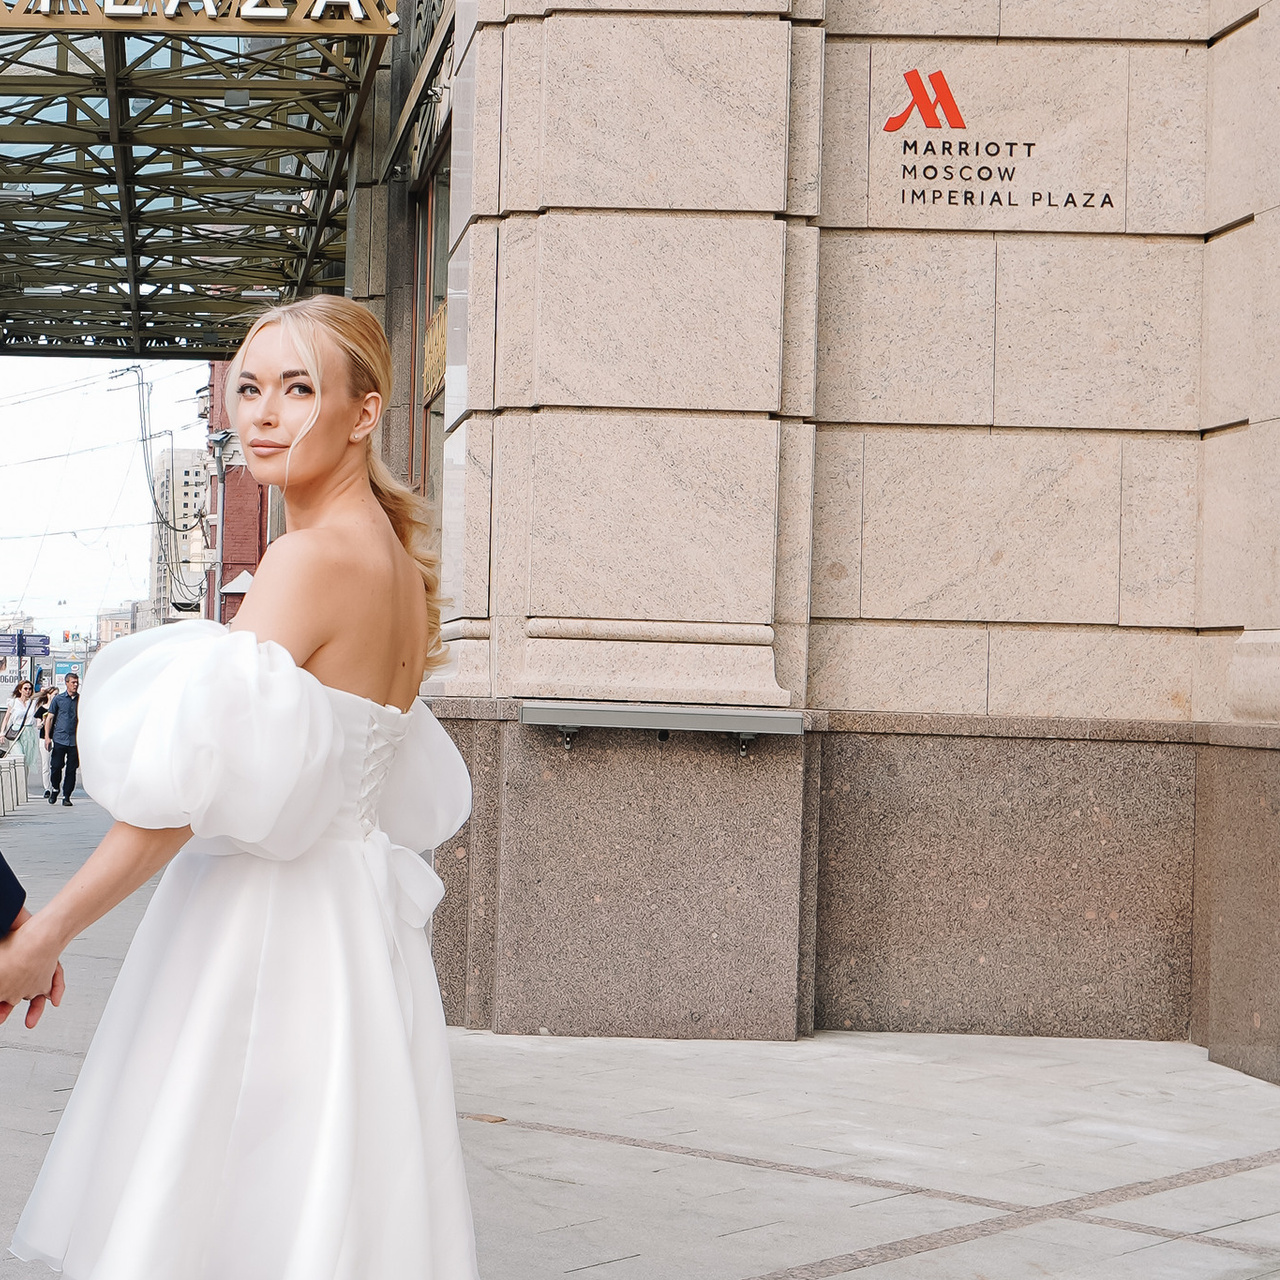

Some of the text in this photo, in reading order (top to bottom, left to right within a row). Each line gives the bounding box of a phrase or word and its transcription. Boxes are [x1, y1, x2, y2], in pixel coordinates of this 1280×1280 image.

[902, 140, 1036, 157] MARRIOTT
[901, 164, 1016, 181] MOSCOW
[901, 189, 1115, 208] IMPERIAL PLAZA
